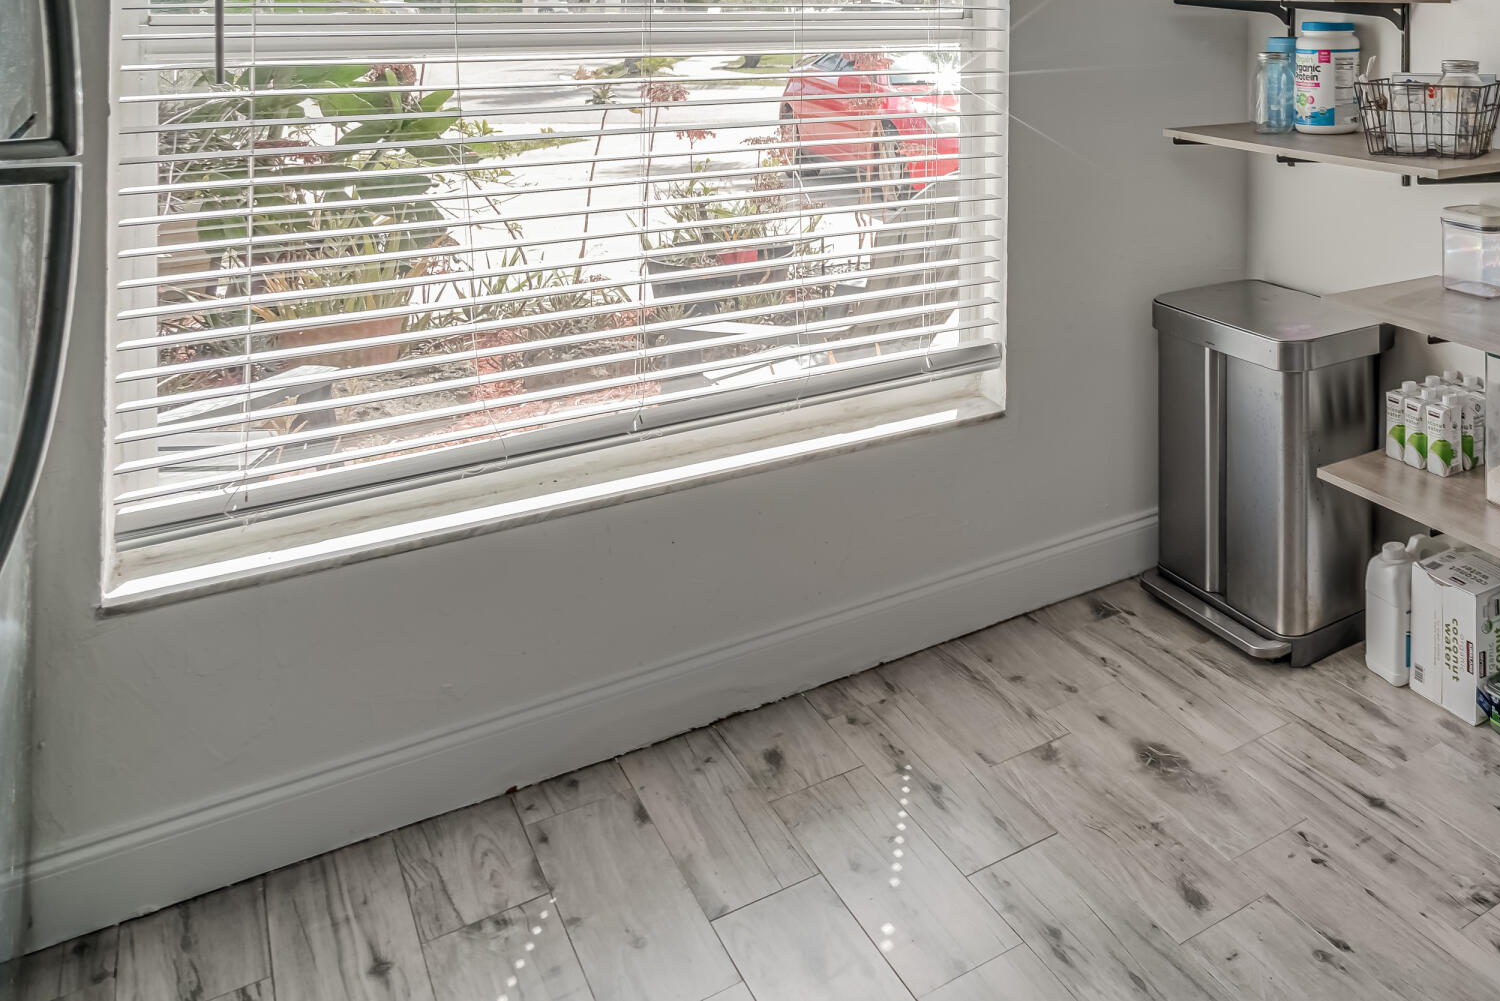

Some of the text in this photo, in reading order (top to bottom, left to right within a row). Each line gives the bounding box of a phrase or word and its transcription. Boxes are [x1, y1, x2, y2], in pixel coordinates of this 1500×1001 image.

[1296, 63, 1321, 74] rganic
[1444, 623, 1452, 671] water
[1452, 618, 1460, 682] coconut
